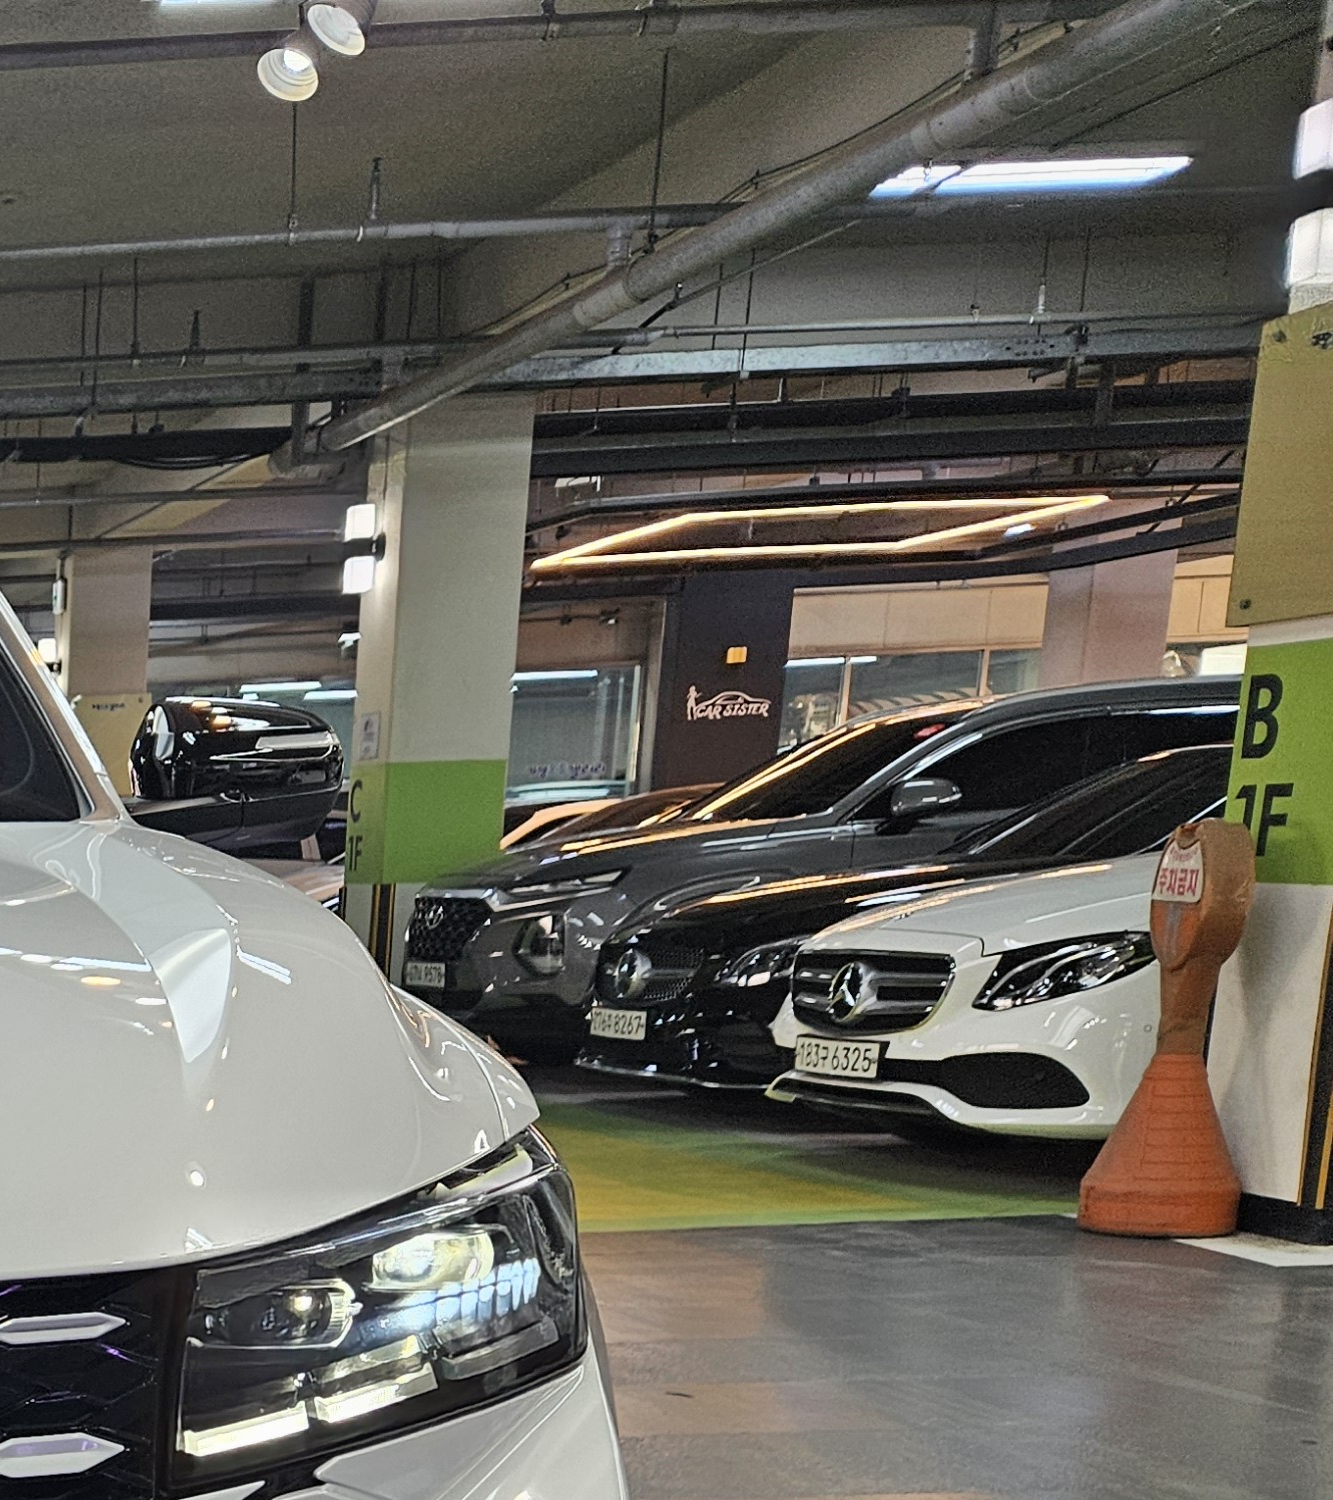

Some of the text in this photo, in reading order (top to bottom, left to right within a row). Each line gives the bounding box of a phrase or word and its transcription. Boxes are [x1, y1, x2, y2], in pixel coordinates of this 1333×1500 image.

[696, 703, 770, 720] CAR SISTER
[1241, 673, 1283, 759] B
[350, 779, 363, 823] C
[1235, 783, 1294, 857] 1F
[831, 1045, 872, 1072] 6325
